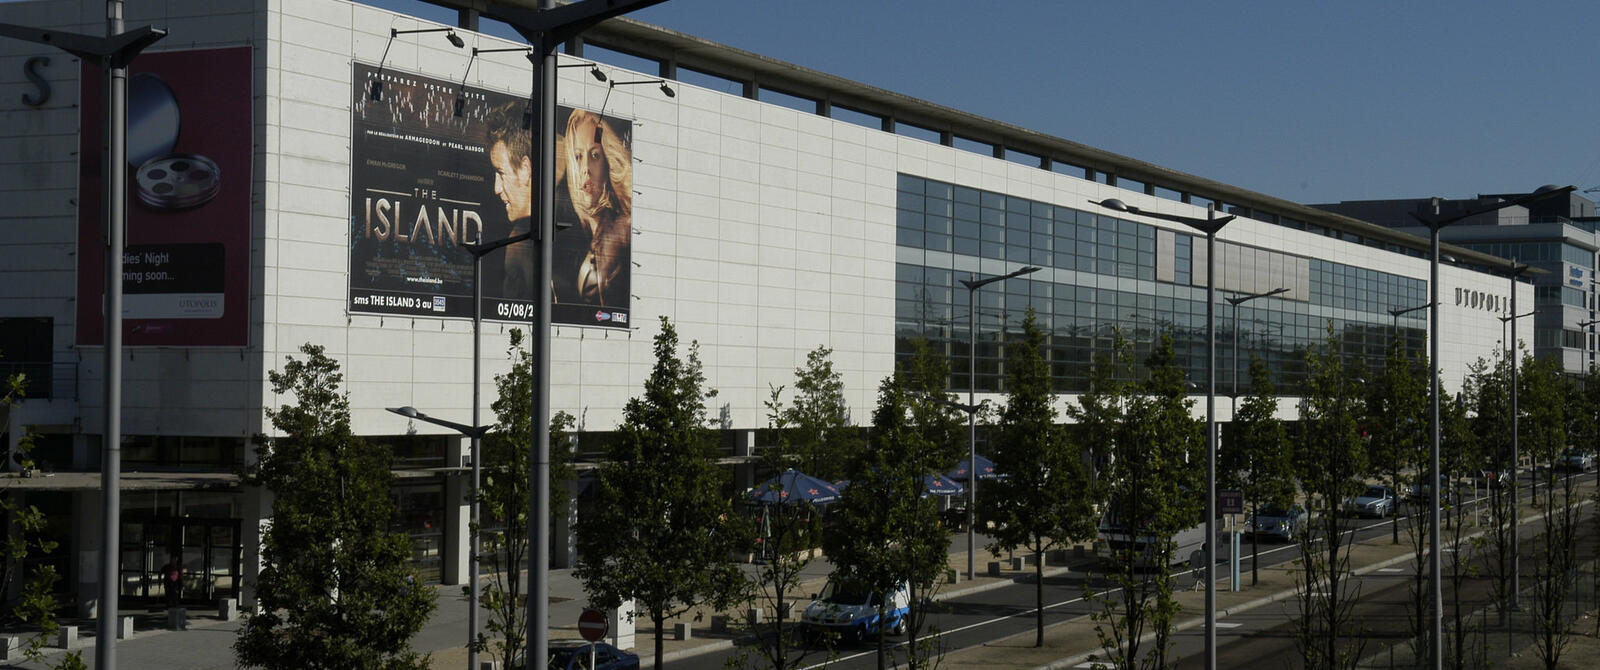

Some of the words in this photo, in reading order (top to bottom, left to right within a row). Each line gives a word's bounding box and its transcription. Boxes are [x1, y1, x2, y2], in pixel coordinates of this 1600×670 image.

[22, 56, 51, 106] S
[423, 83, 453, 94] VOTRE
[464, 91, 486, 101] UITE
[404, 135, 440, 146] ARMAGEDDON
[448, 142, 464, 150] PEARL
[464, 145, 485, 153] HARBOR
[414, 188, 437, 200] THE
[365, 197, 483, 247] ISLAND
[122, 252, 143, 264] dies'
[145, 252, 169, 266] Night
[122, 269, 143, 284] ming
[145, 271, 175, 281] soon...
[353, 296, 369, 305] sms
[370, 295, 385, 306] THE
[386, 296, 414, 308] ISLAND
[415, 299, 421, 309] 3
[422, 301, 432, 309] au
[498, 302, 534, 319] 05/08/2
